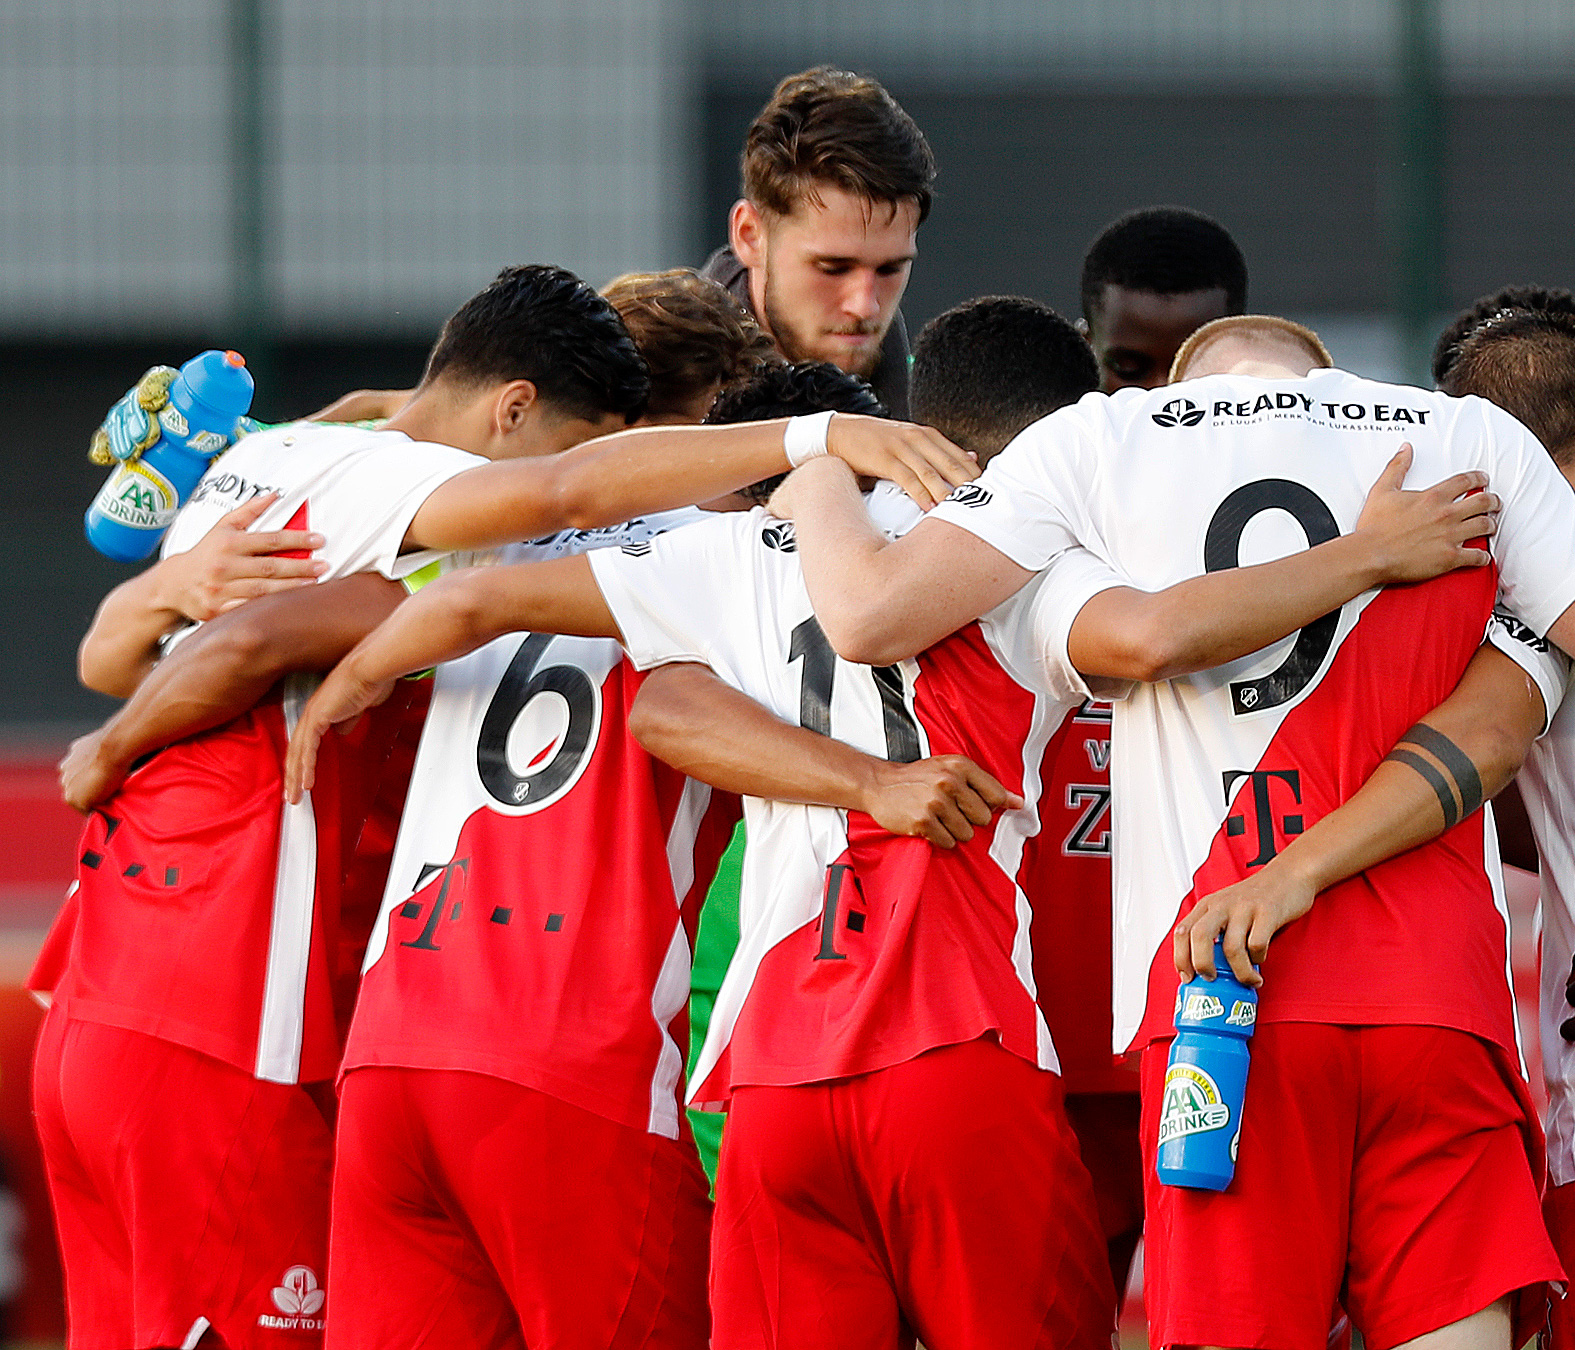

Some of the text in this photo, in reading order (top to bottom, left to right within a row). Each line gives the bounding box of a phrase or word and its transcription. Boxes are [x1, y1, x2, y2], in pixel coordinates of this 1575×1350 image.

[1213, 392, 1431, 425] READY TO EAT
[1306, 416, 1326, 427] VAN
[1329, 422, 1382, 432] LUKASSEN
[108, 500, 160, 526] DRINK
[120, 480, 158, 513] AA
[1204, 479, 1343, 716] 9
[477, 632, 595, 807] 6
[1222, 769, 1304, 868] T
[400, 856, 471, 951] T
[1164, 1085, 1203, 1121] AA
[1160, 1111, 1212, 1140] DRINK
[258, 1314, 299, 1329] READY
[301, 1318, 316, 1329] TO
